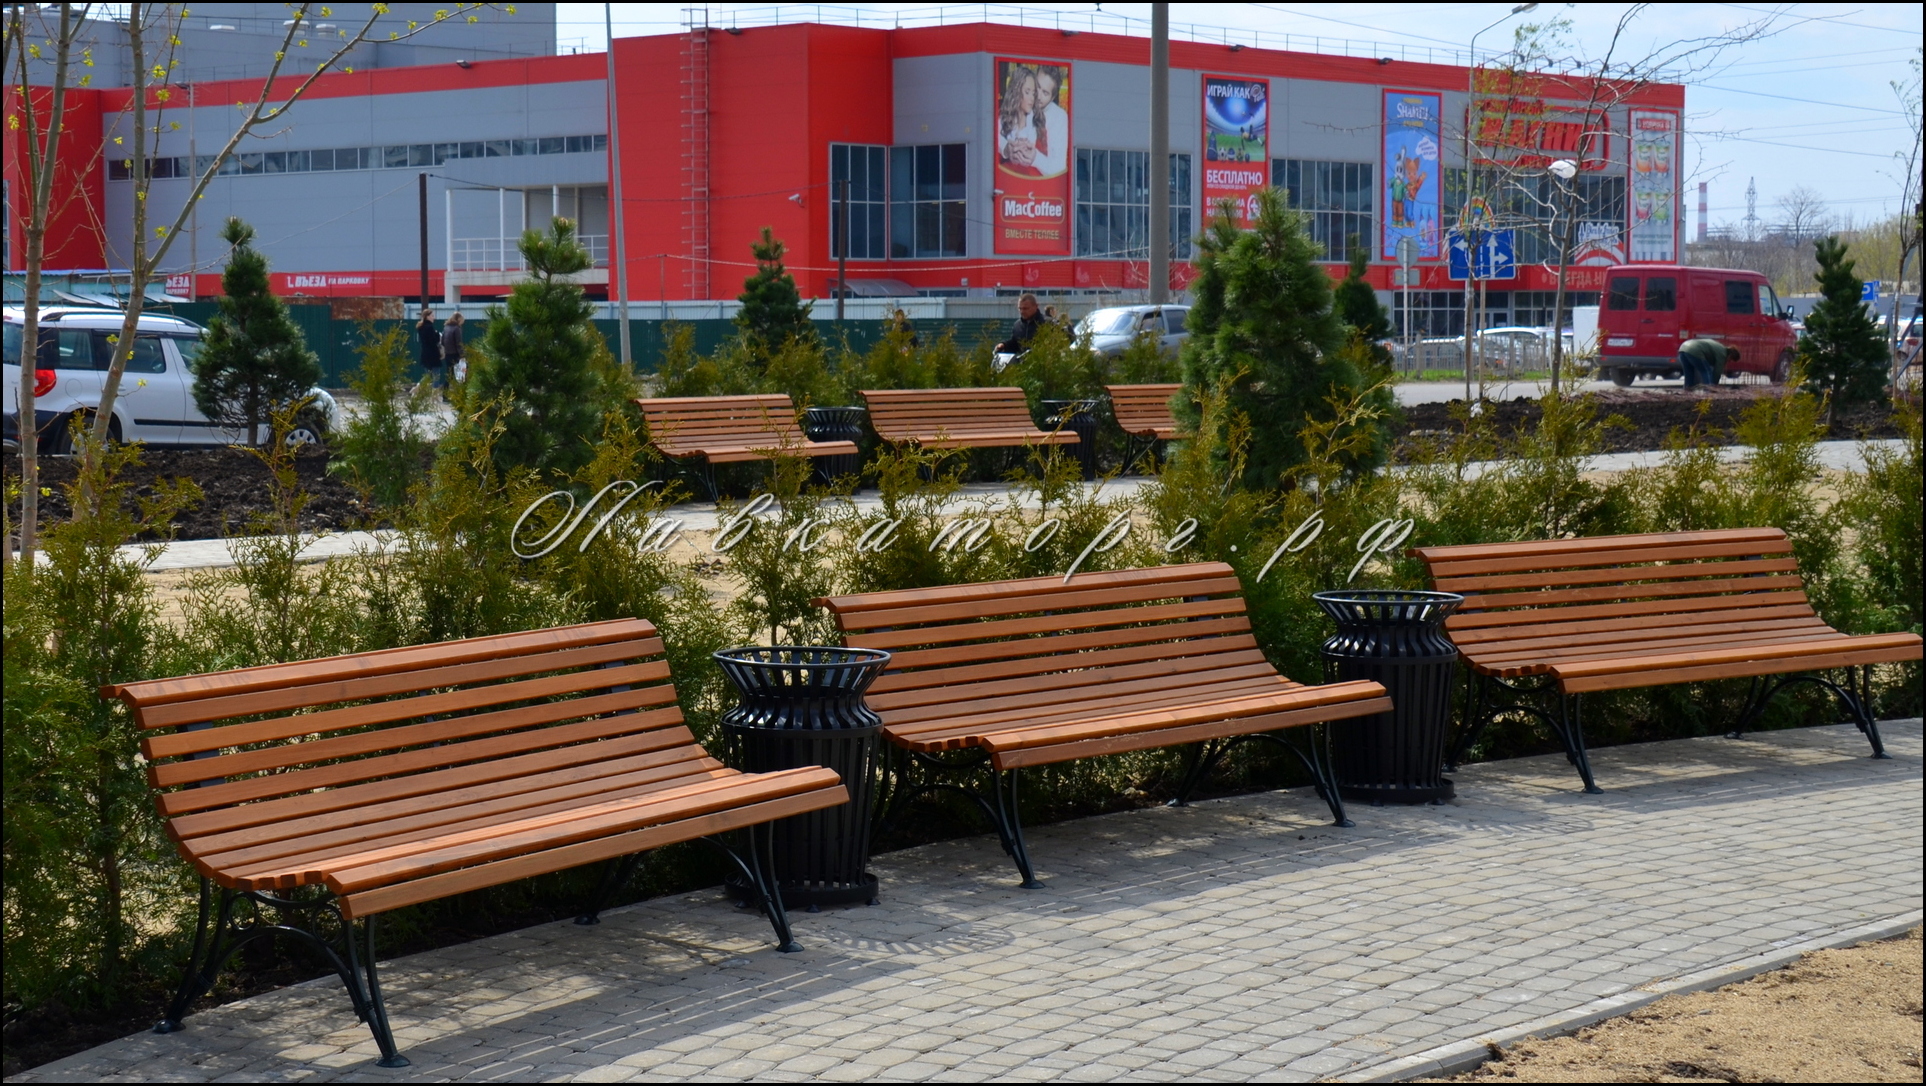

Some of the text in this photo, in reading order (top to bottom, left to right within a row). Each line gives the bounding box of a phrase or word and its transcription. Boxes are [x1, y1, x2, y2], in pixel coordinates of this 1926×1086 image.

[1207, 84, 1250, 99] ИГРАЙ КАК
[1206, 169, 1263, 186] БЕСПЛАТНО
[1004, 200, 1063, 218] MacCoffee
[1005, 228, 1060, 240] ВМЕСТЕ ТЕПЛЕЕ
[165, 276, 190, 288] ЪЕЗД
[295, 276, 326, 287] ВЪЕЗД
[337, 277, 369, 285] ПАРКОВКУ
[1549, 271, 1593, 288] ВЕГДА
